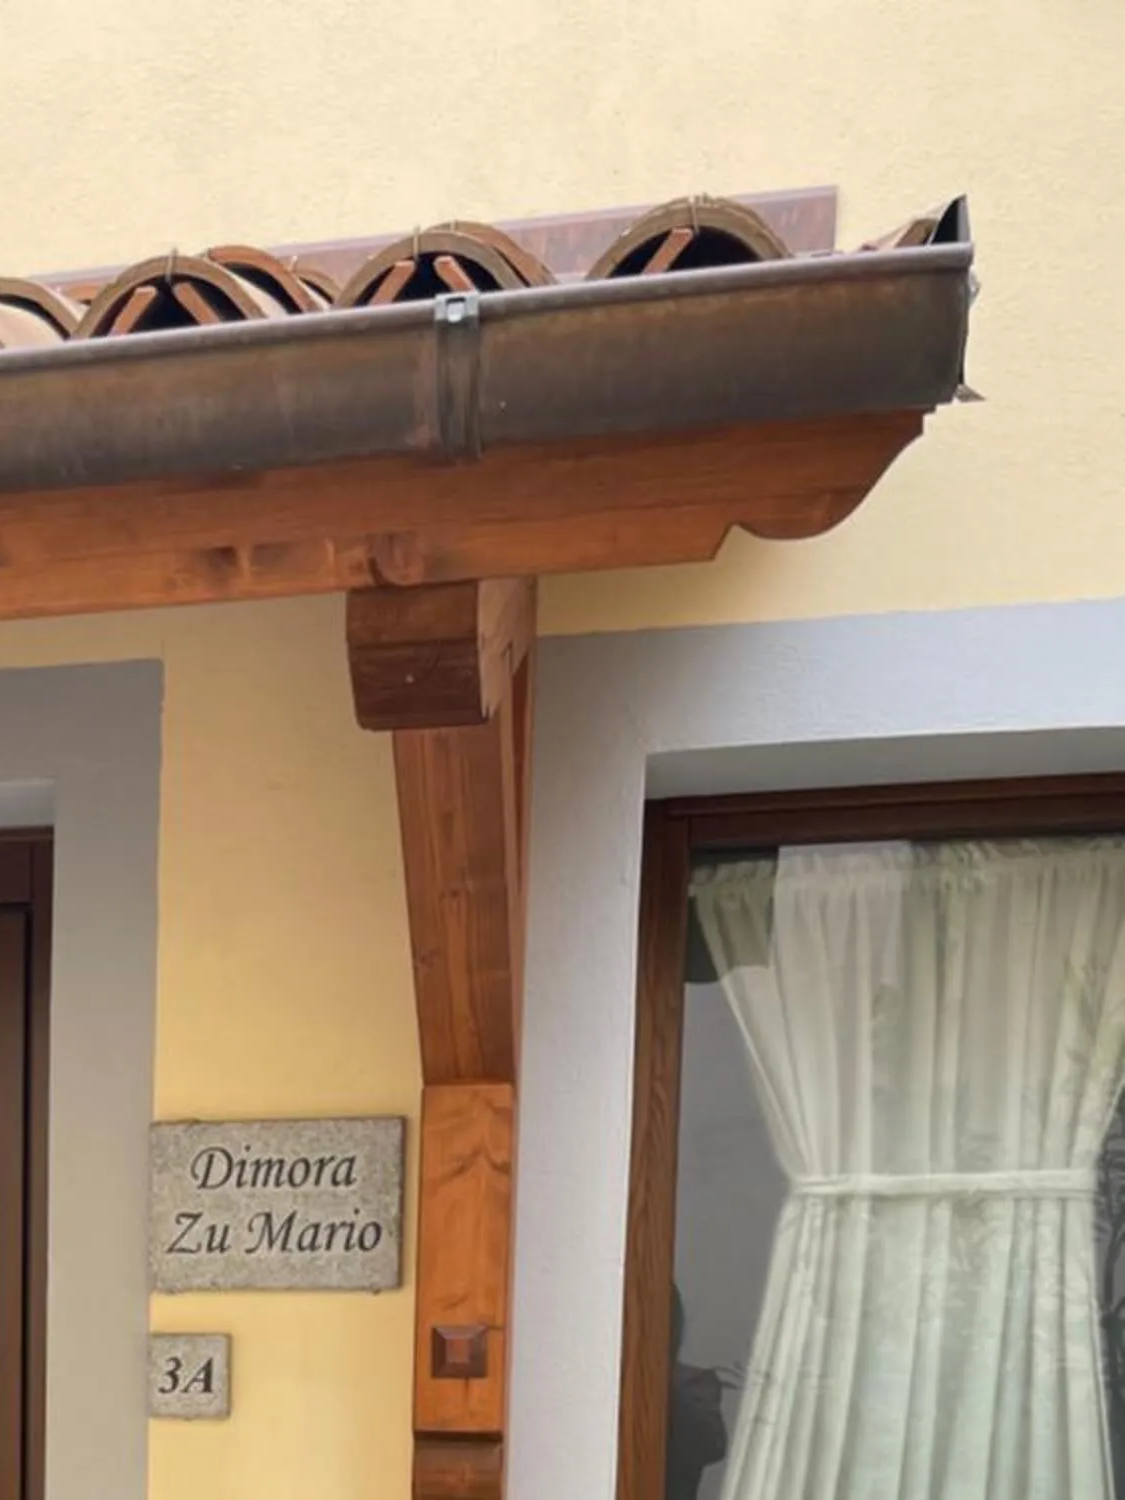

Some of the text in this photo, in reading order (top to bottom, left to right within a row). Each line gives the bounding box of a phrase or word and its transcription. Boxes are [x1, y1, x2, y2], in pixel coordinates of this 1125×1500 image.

[190, 1145, 358, 1189] Dimora
[166, 1208, 383, 1254] Zu Mario
[158, 1356, 213, 1394] 3A
